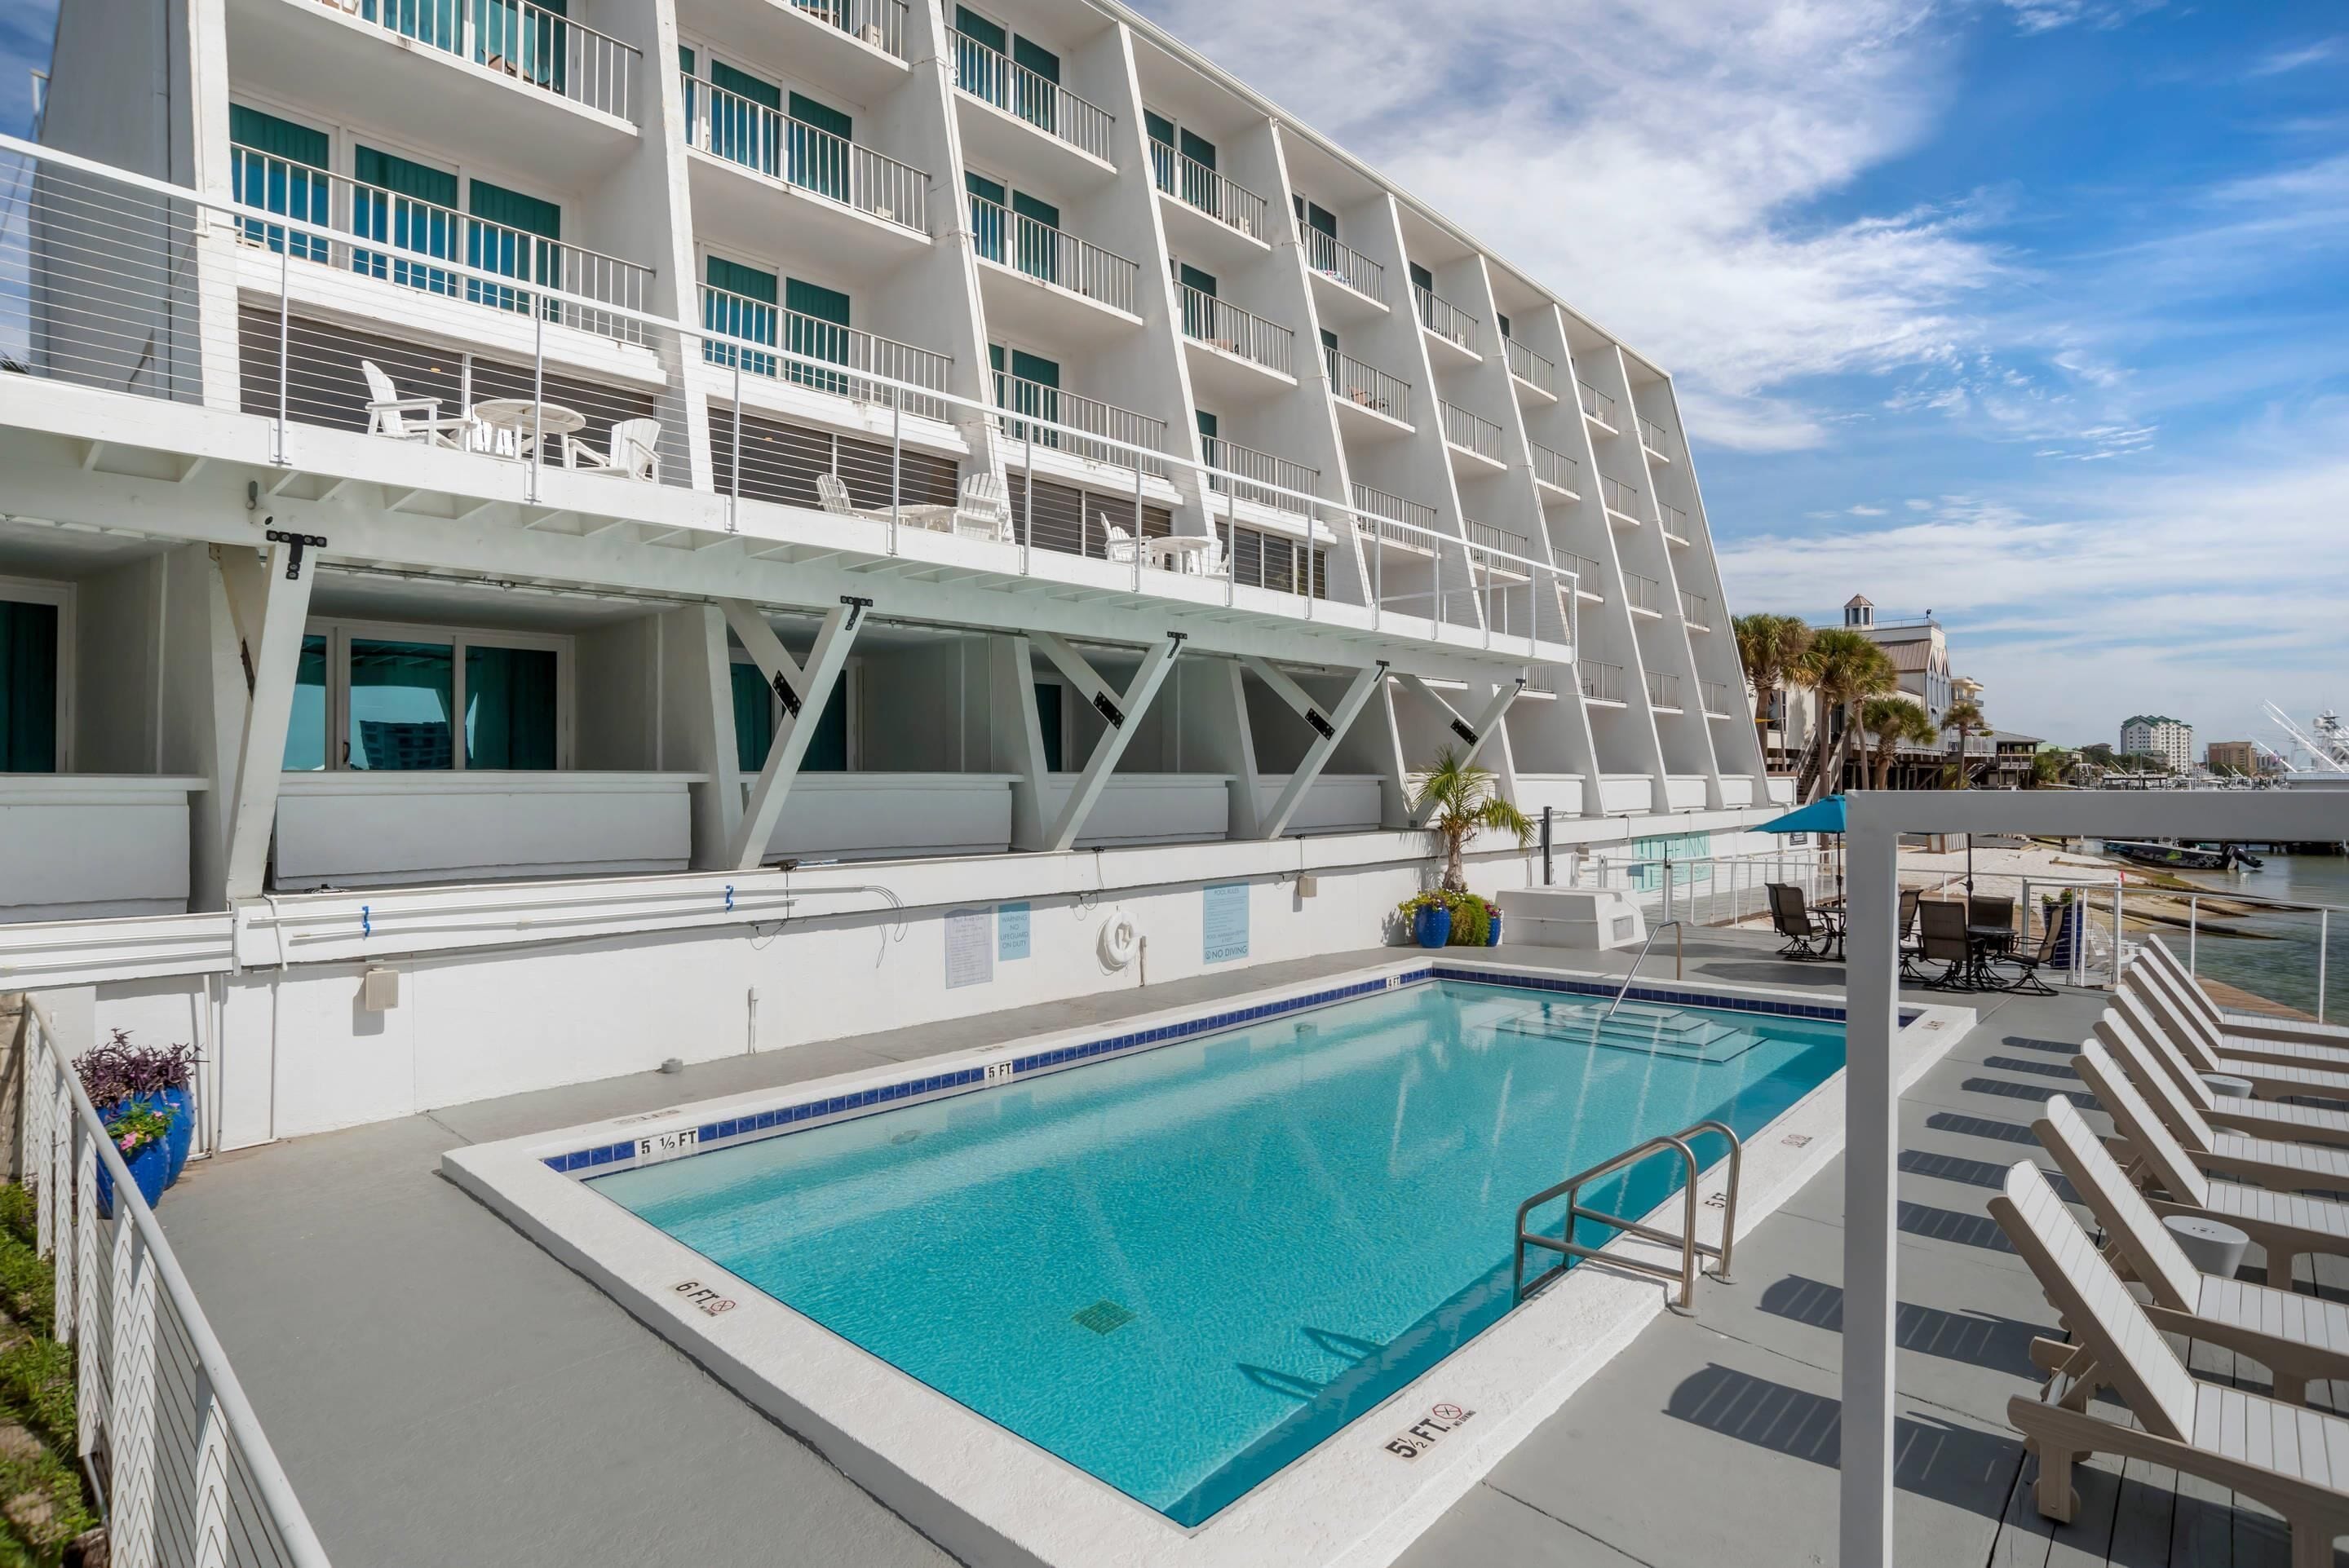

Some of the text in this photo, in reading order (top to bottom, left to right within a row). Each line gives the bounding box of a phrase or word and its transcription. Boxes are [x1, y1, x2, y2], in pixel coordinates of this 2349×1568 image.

[1000, 931, 1029, 940] LIFEGUARD
[1013, 939, 1026, 947] DUTY
[1212, 945, 1247, 959] NO DIVING
[1394, 977, 1399, 985] FT
[989, 1063, 1011, 1078] 5 FT
[641, 1140, 651, 1154] 5
[679, 1130, 697, 1146] FT
[675, 1283, 699, 1292] 6
[1458, 1410, 1477, 1423] DIVING
[1409, 1418, 1451, 1442] FT.
